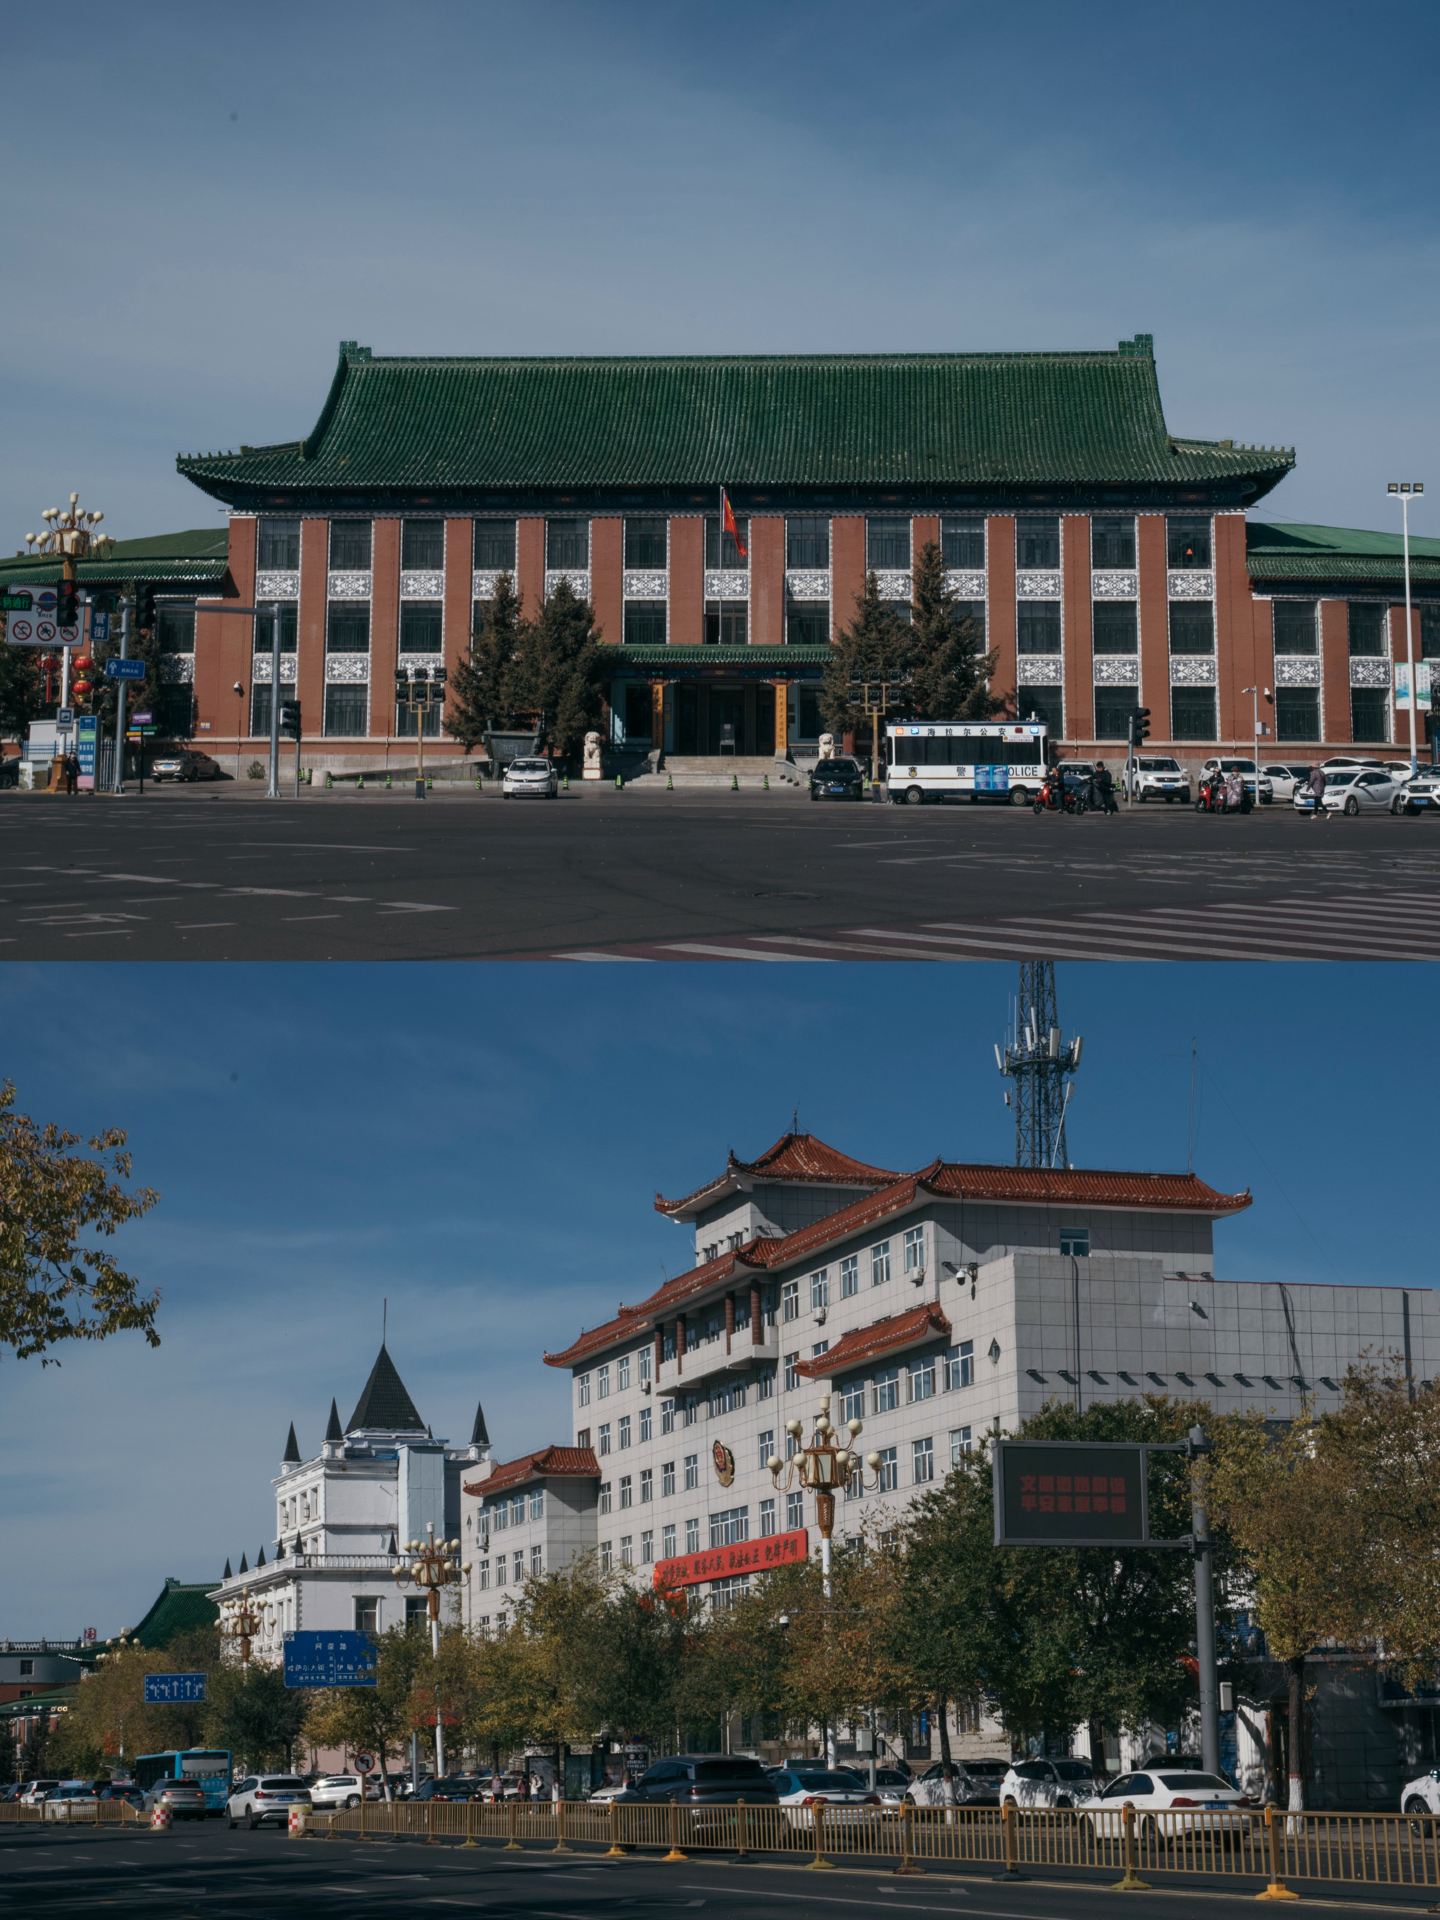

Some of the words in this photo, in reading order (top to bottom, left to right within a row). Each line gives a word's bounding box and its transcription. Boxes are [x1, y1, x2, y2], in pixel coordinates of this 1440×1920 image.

[927, 728, 1007, 737] 海拉尔公安
[956, 766, 966, 777] 警
[1008, 766, 1038, 777] OLICE
